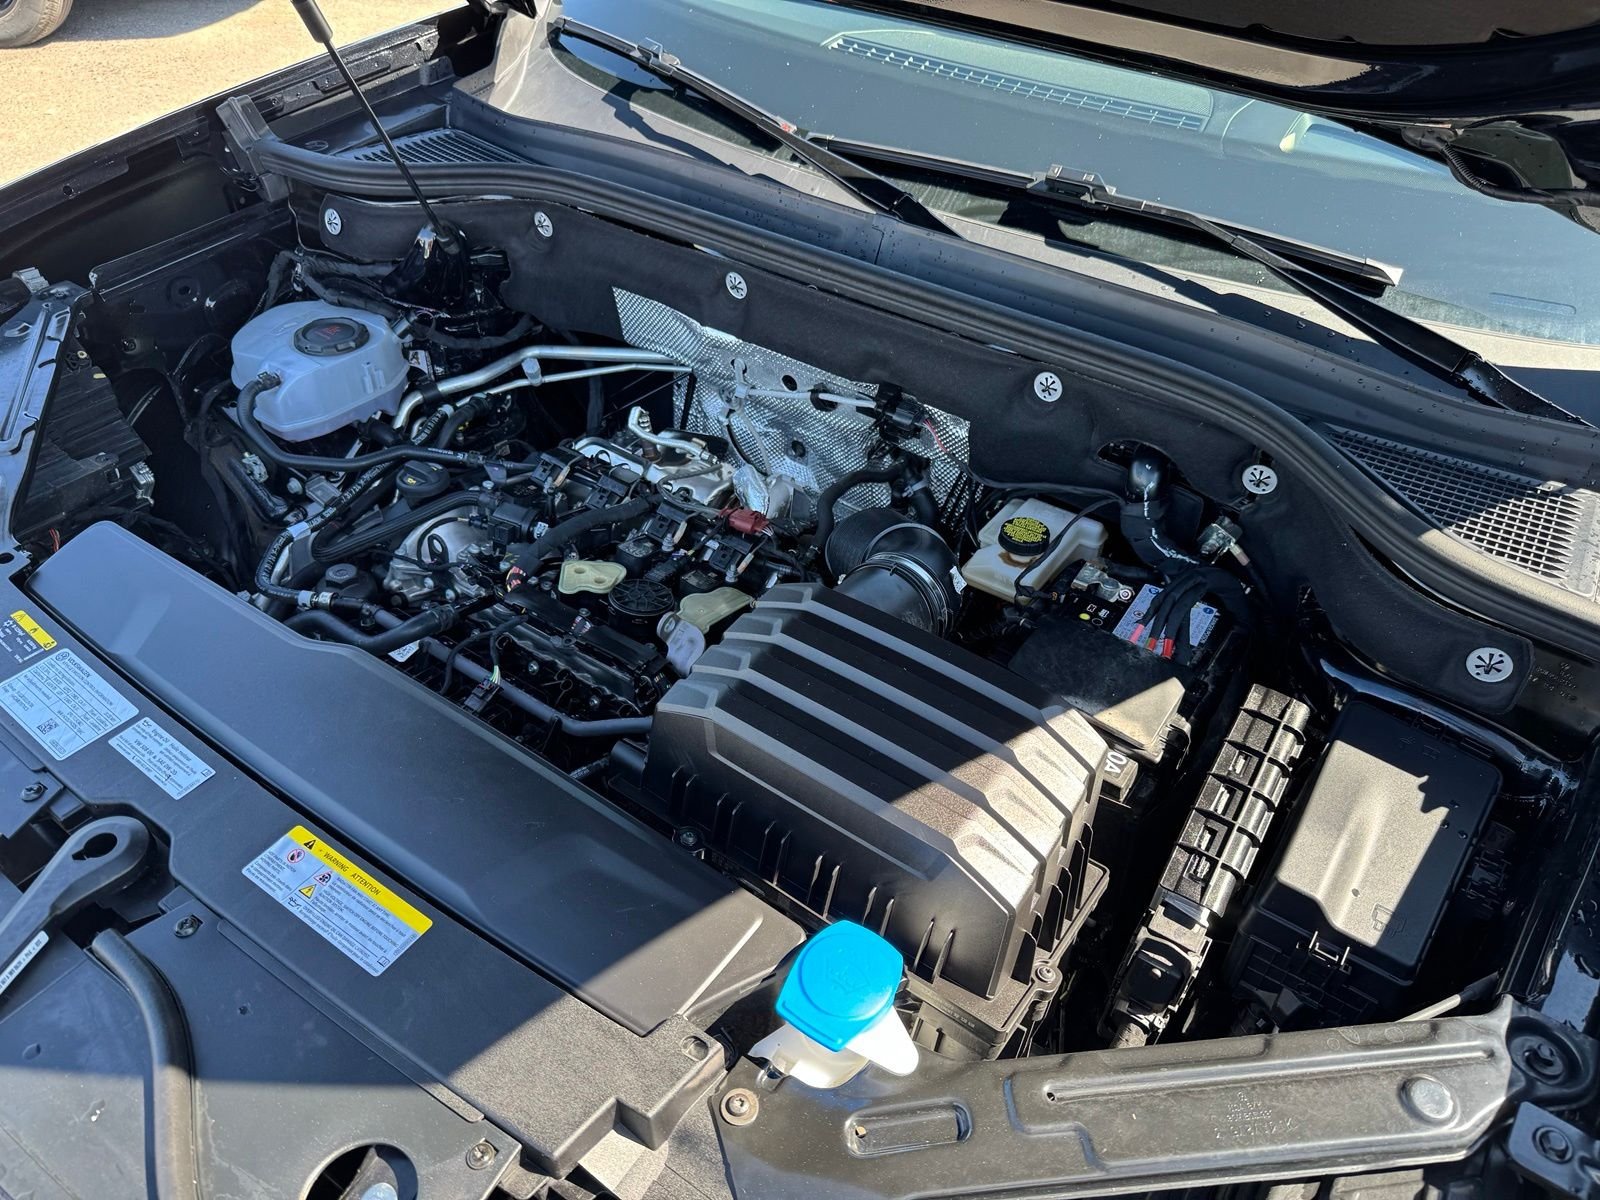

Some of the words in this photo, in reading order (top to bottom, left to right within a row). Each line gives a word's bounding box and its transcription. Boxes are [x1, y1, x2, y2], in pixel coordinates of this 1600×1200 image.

[66, 657, 92, 677] VOLKSWAGEN
[323, 852, 350, 872] WARNING
[350, 872, 381, 896] ATTENTION
